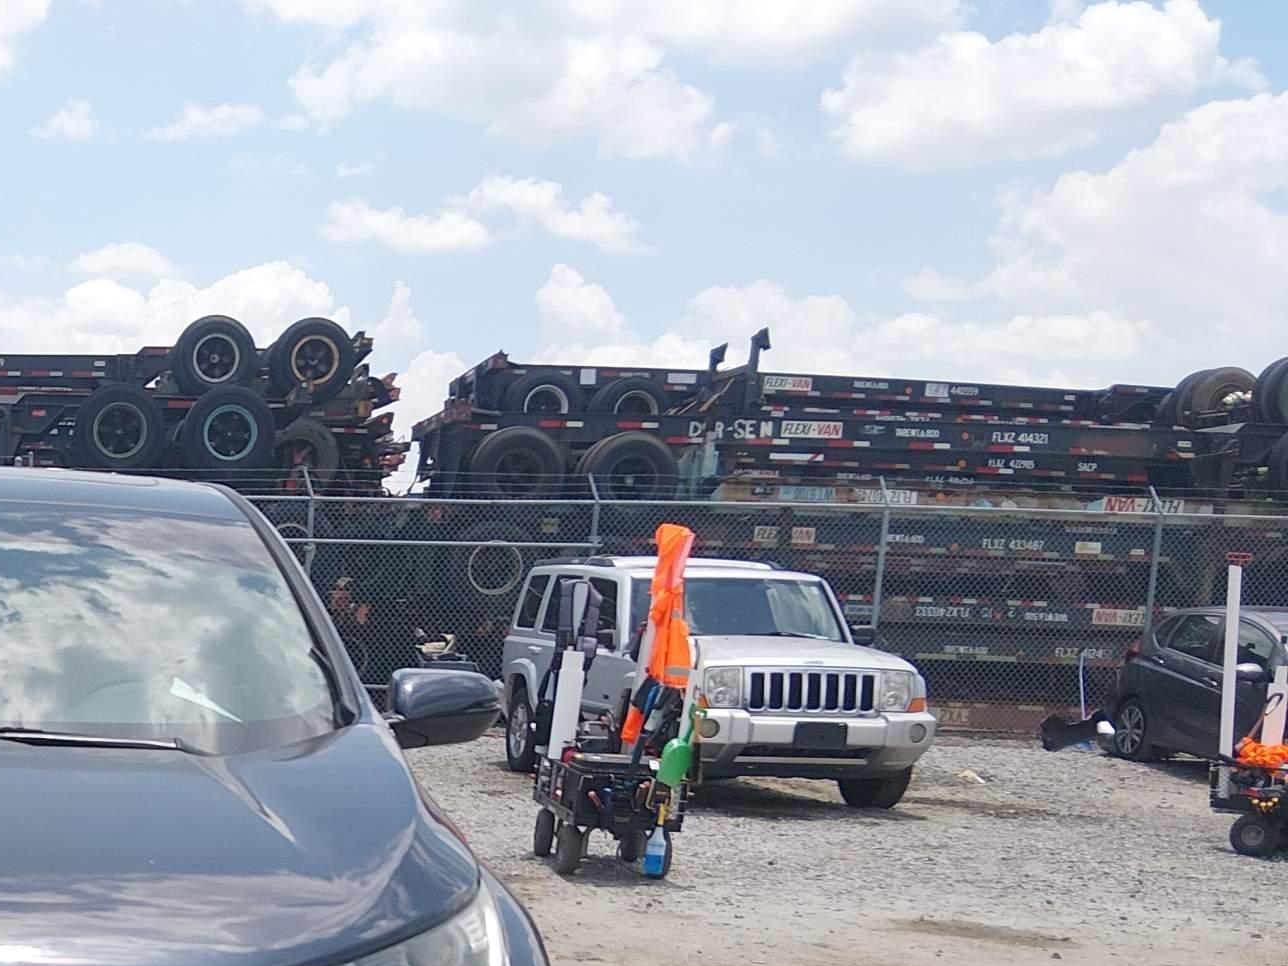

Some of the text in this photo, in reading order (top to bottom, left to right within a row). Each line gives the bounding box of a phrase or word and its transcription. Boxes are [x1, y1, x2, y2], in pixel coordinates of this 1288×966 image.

[783, 422, 841, 438] FLEXI-VAN
[992, 431, 1049, 445] FLXZ 414321
[1077, 462, 1098, 472] SACP
